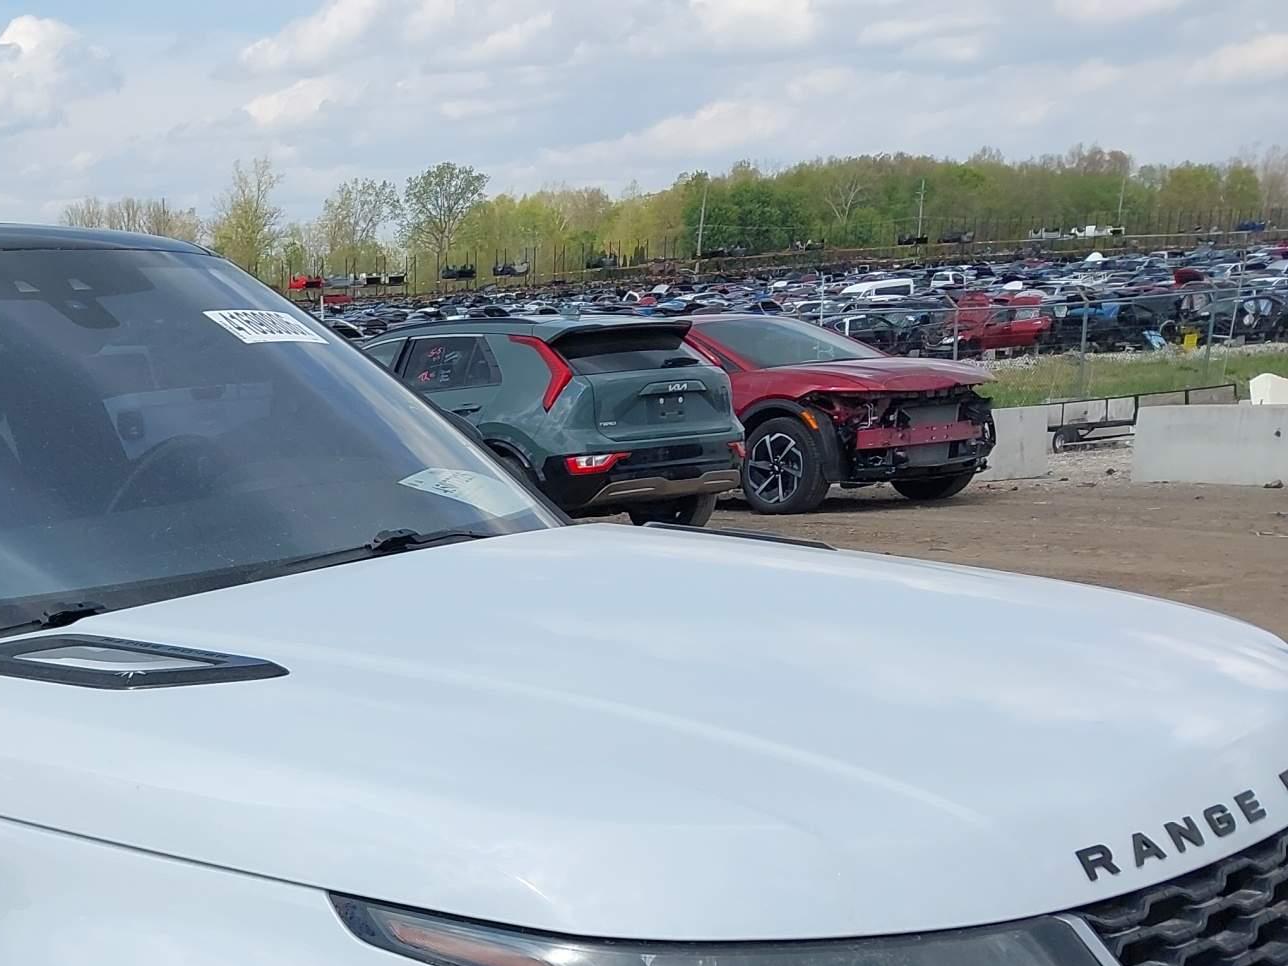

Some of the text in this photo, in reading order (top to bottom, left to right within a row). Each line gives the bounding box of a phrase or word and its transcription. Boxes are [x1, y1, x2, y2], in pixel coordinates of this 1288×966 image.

[217, 311, 309, 336] 41690806
[668, 383, 688, 392] KIA
[1075, 789, 1267, 882] RANGE
